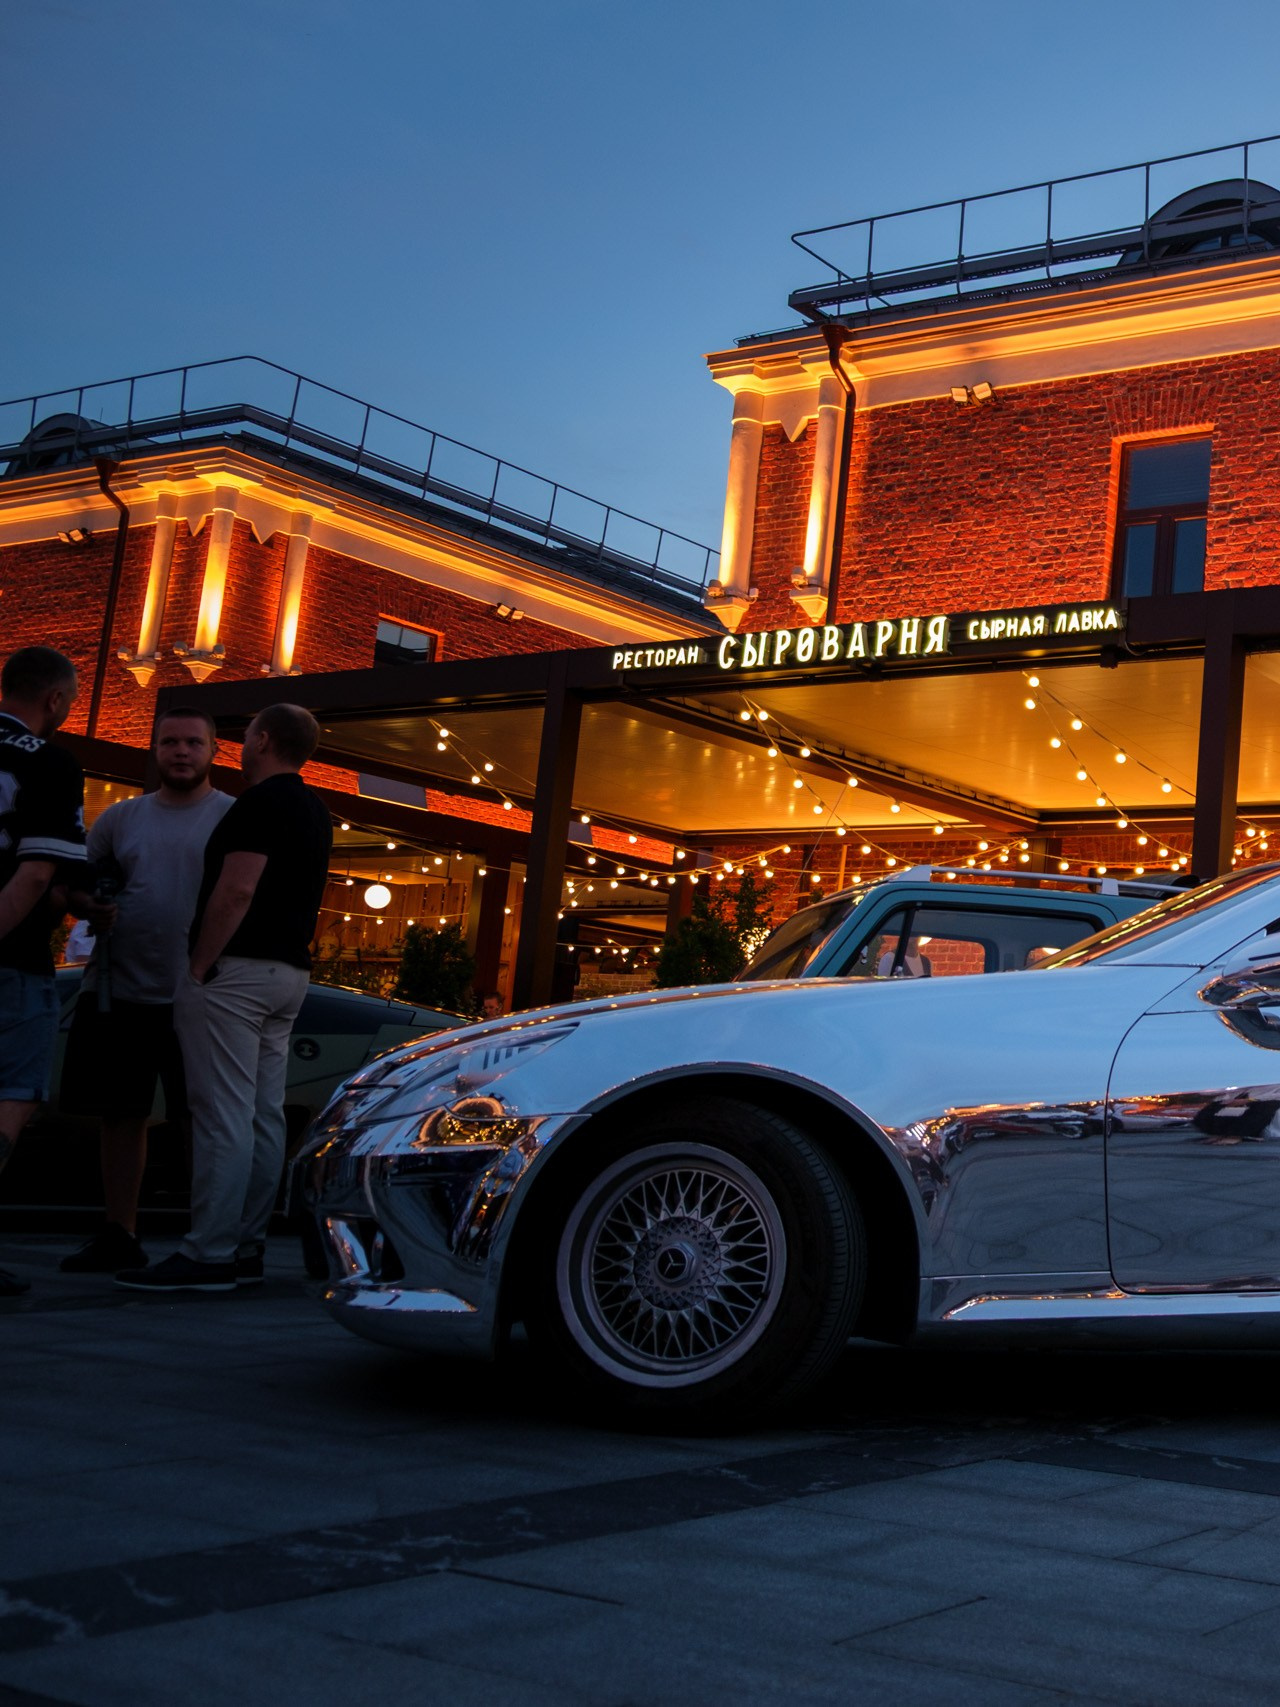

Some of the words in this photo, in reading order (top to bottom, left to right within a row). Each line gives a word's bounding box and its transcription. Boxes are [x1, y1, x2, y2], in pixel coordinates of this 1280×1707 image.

[612, 647, 700, 671] РЕСТОРАН
[967, 613, 1046, 641] СЫРНАЯ
[1055, 608, 1119, 634] ЛАВКА
